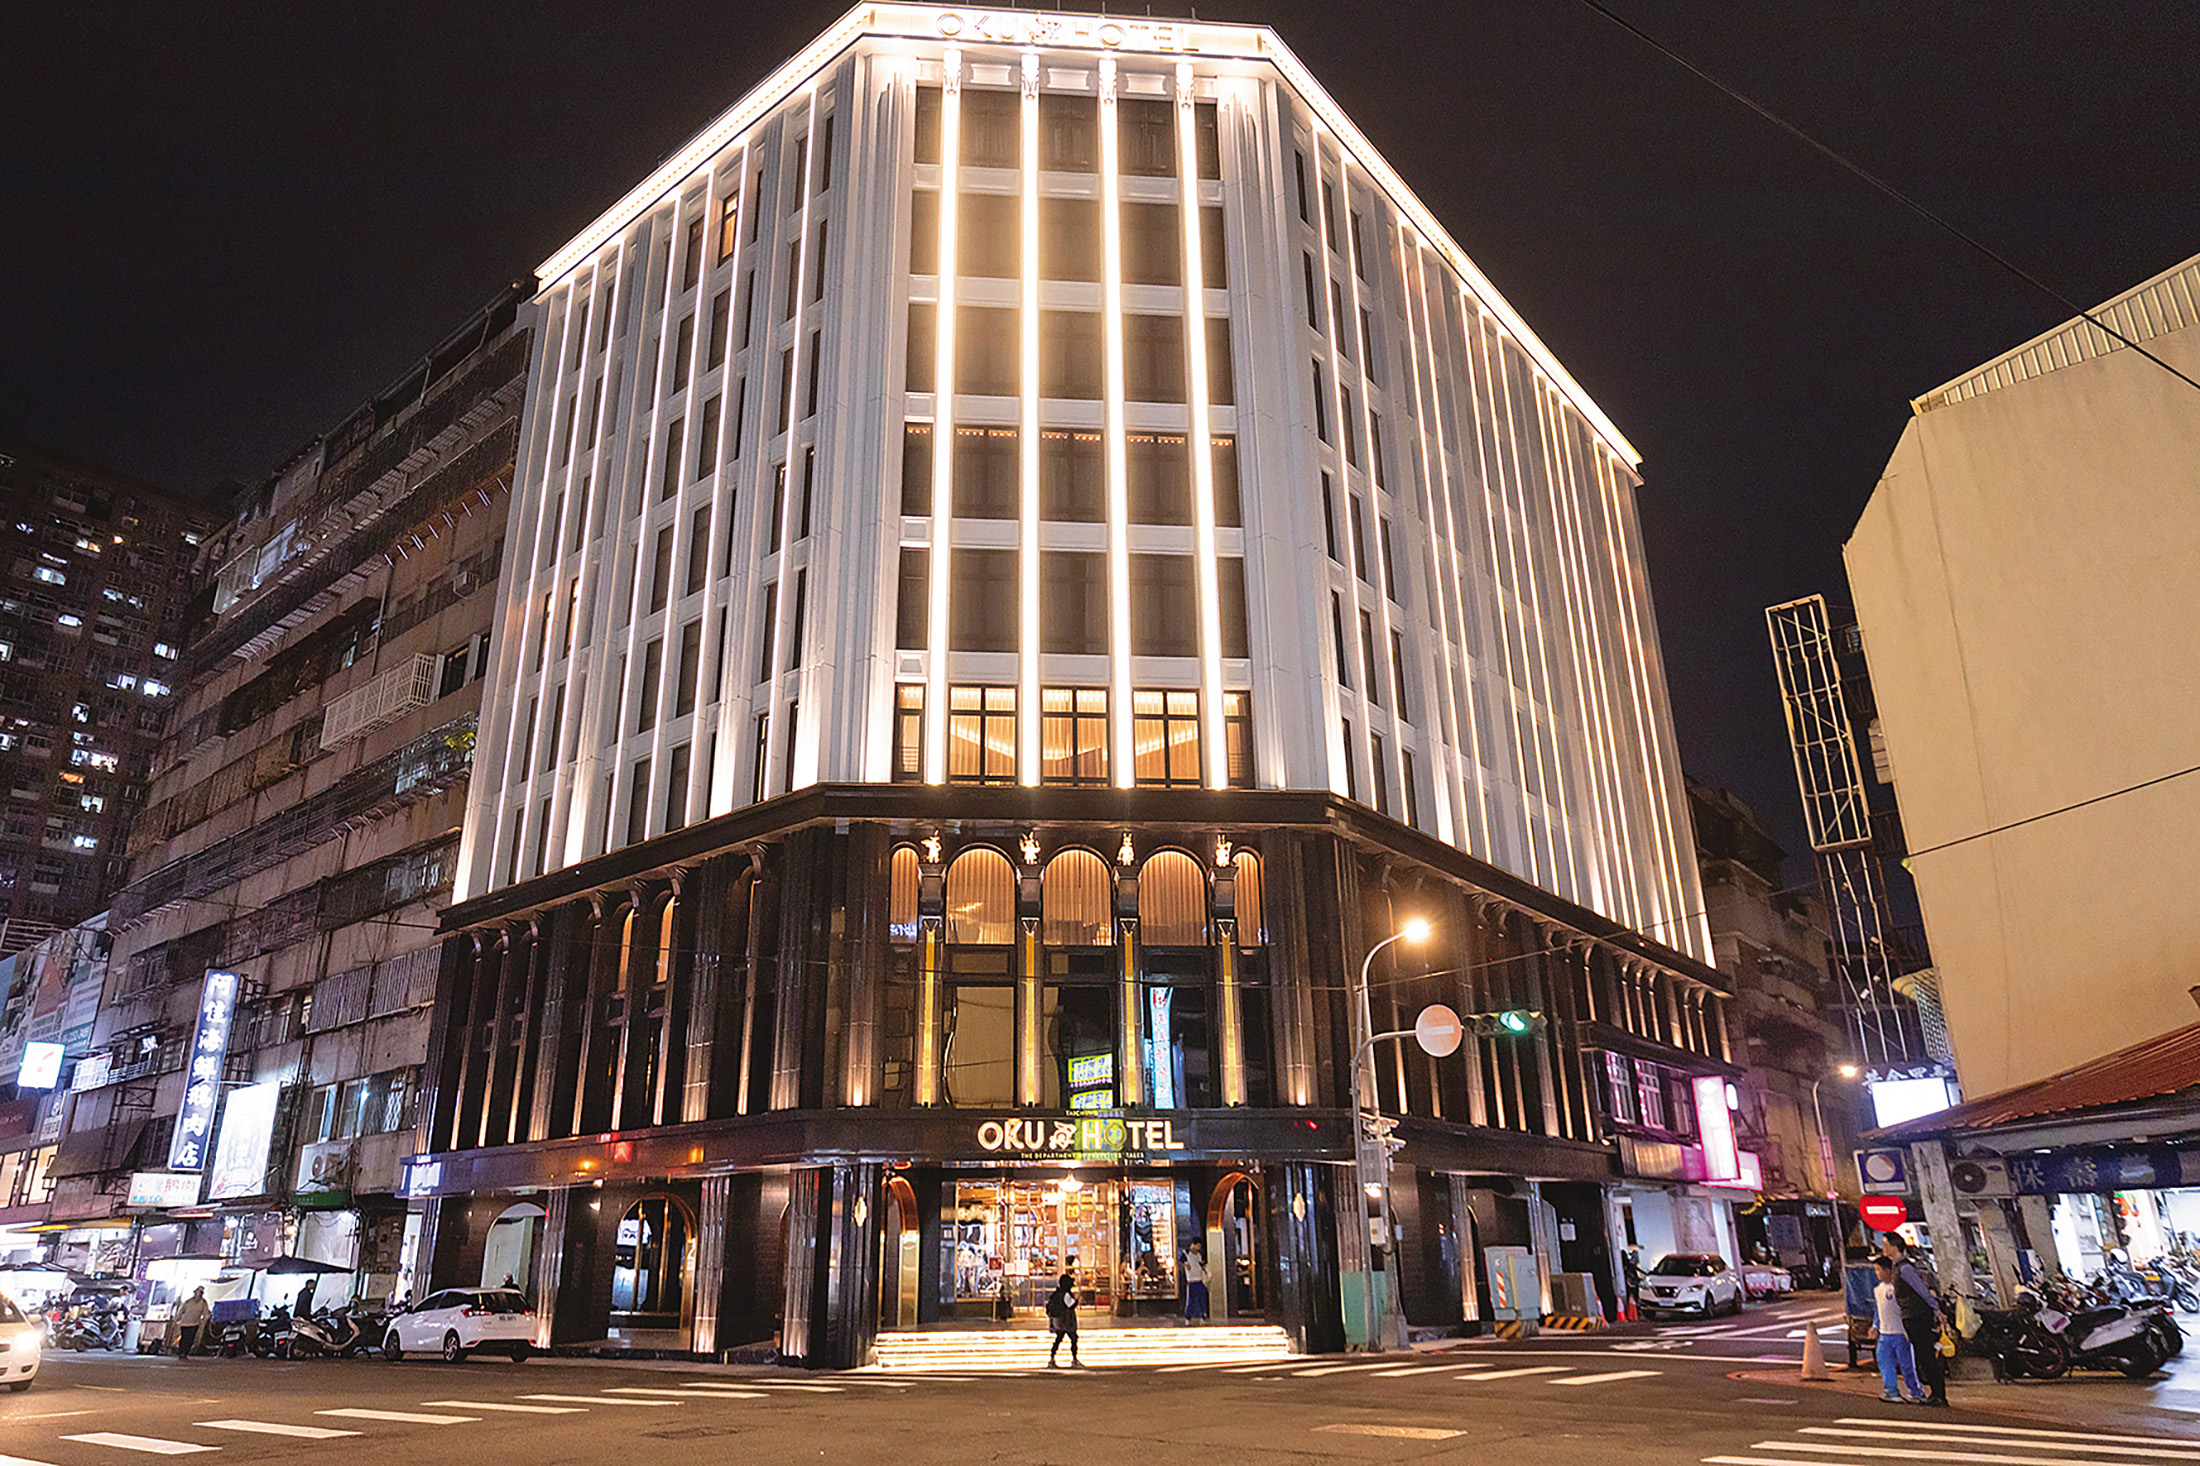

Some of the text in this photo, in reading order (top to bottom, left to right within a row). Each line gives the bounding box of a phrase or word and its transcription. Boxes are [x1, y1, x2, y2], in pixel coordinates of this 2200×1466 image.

[935, 12, 1200, 53] OKU HOTEL
[977, 1118, 1185, 1151] OKU HOTEL
